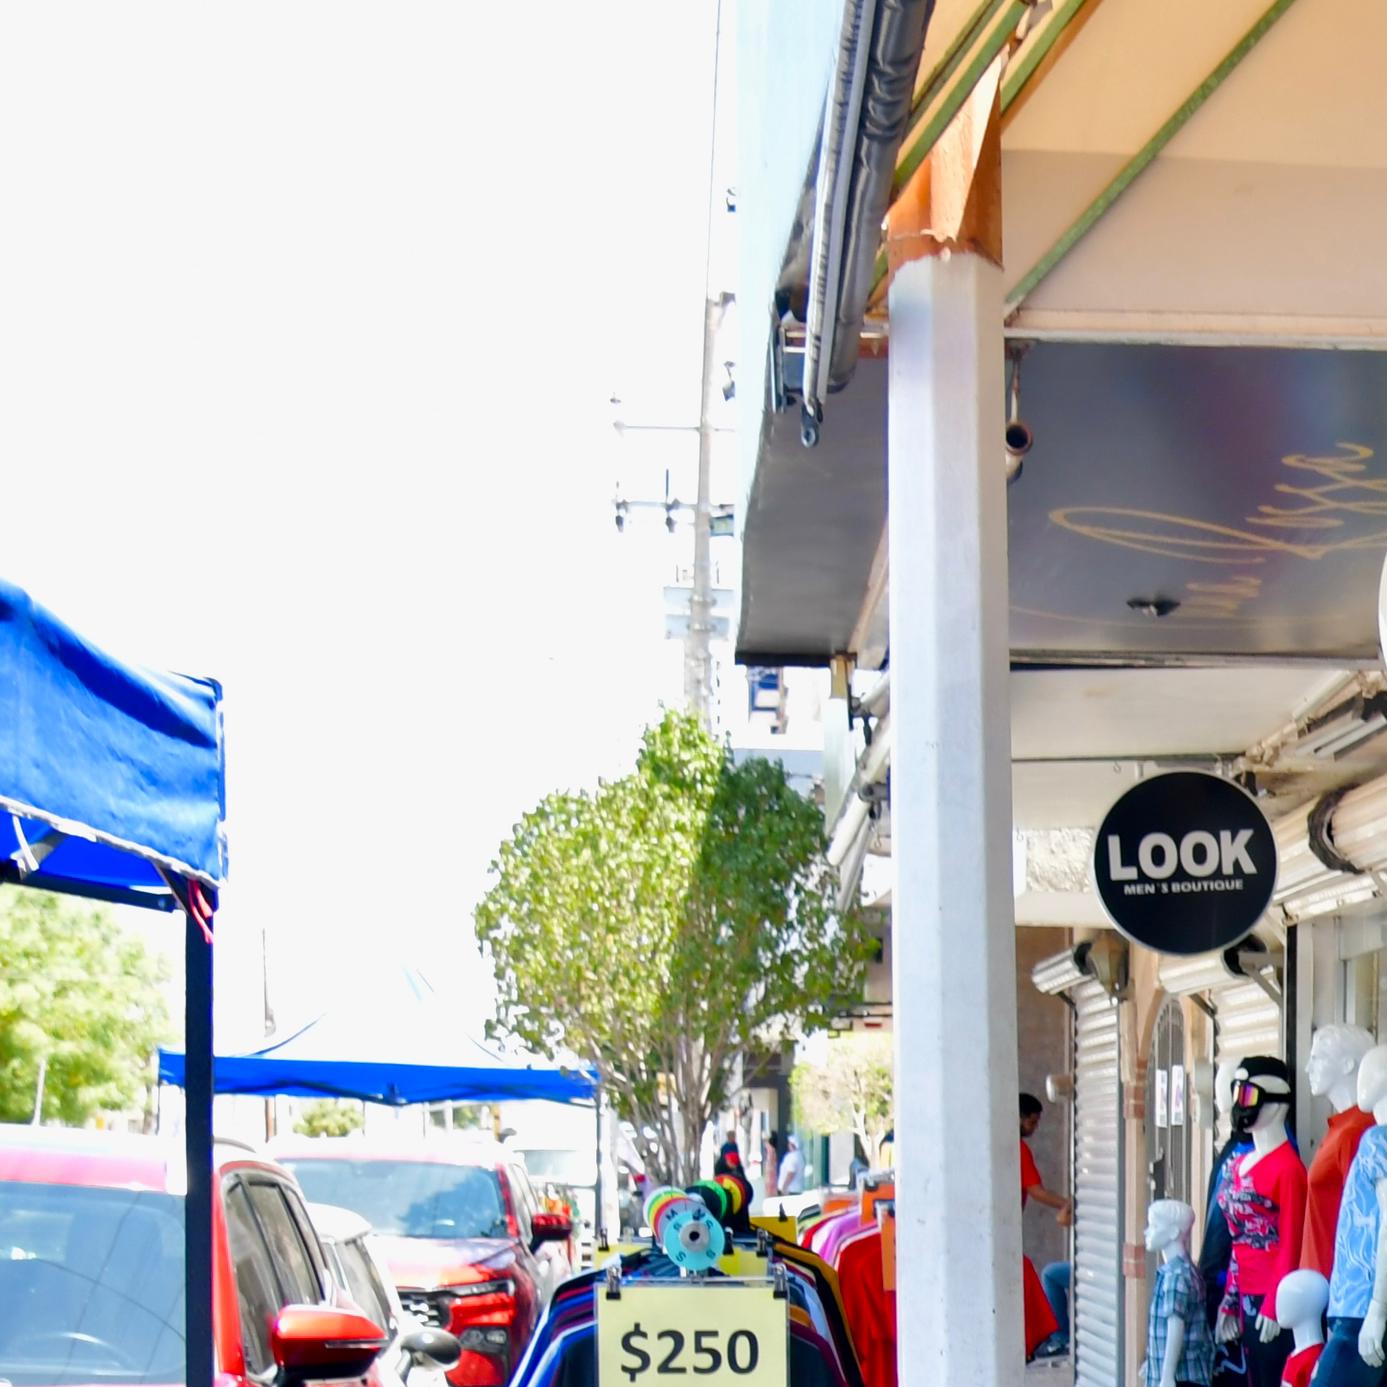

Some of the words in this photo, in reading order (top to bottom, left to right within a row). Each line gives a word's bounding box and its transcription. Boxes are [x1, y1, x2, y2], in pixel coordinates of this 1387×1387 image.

[1107, 829, 1258, 881] LOOK
[1171, 879, 1244, 893] BOUTIQUE
[621, 1322, 759, 1383] $250
